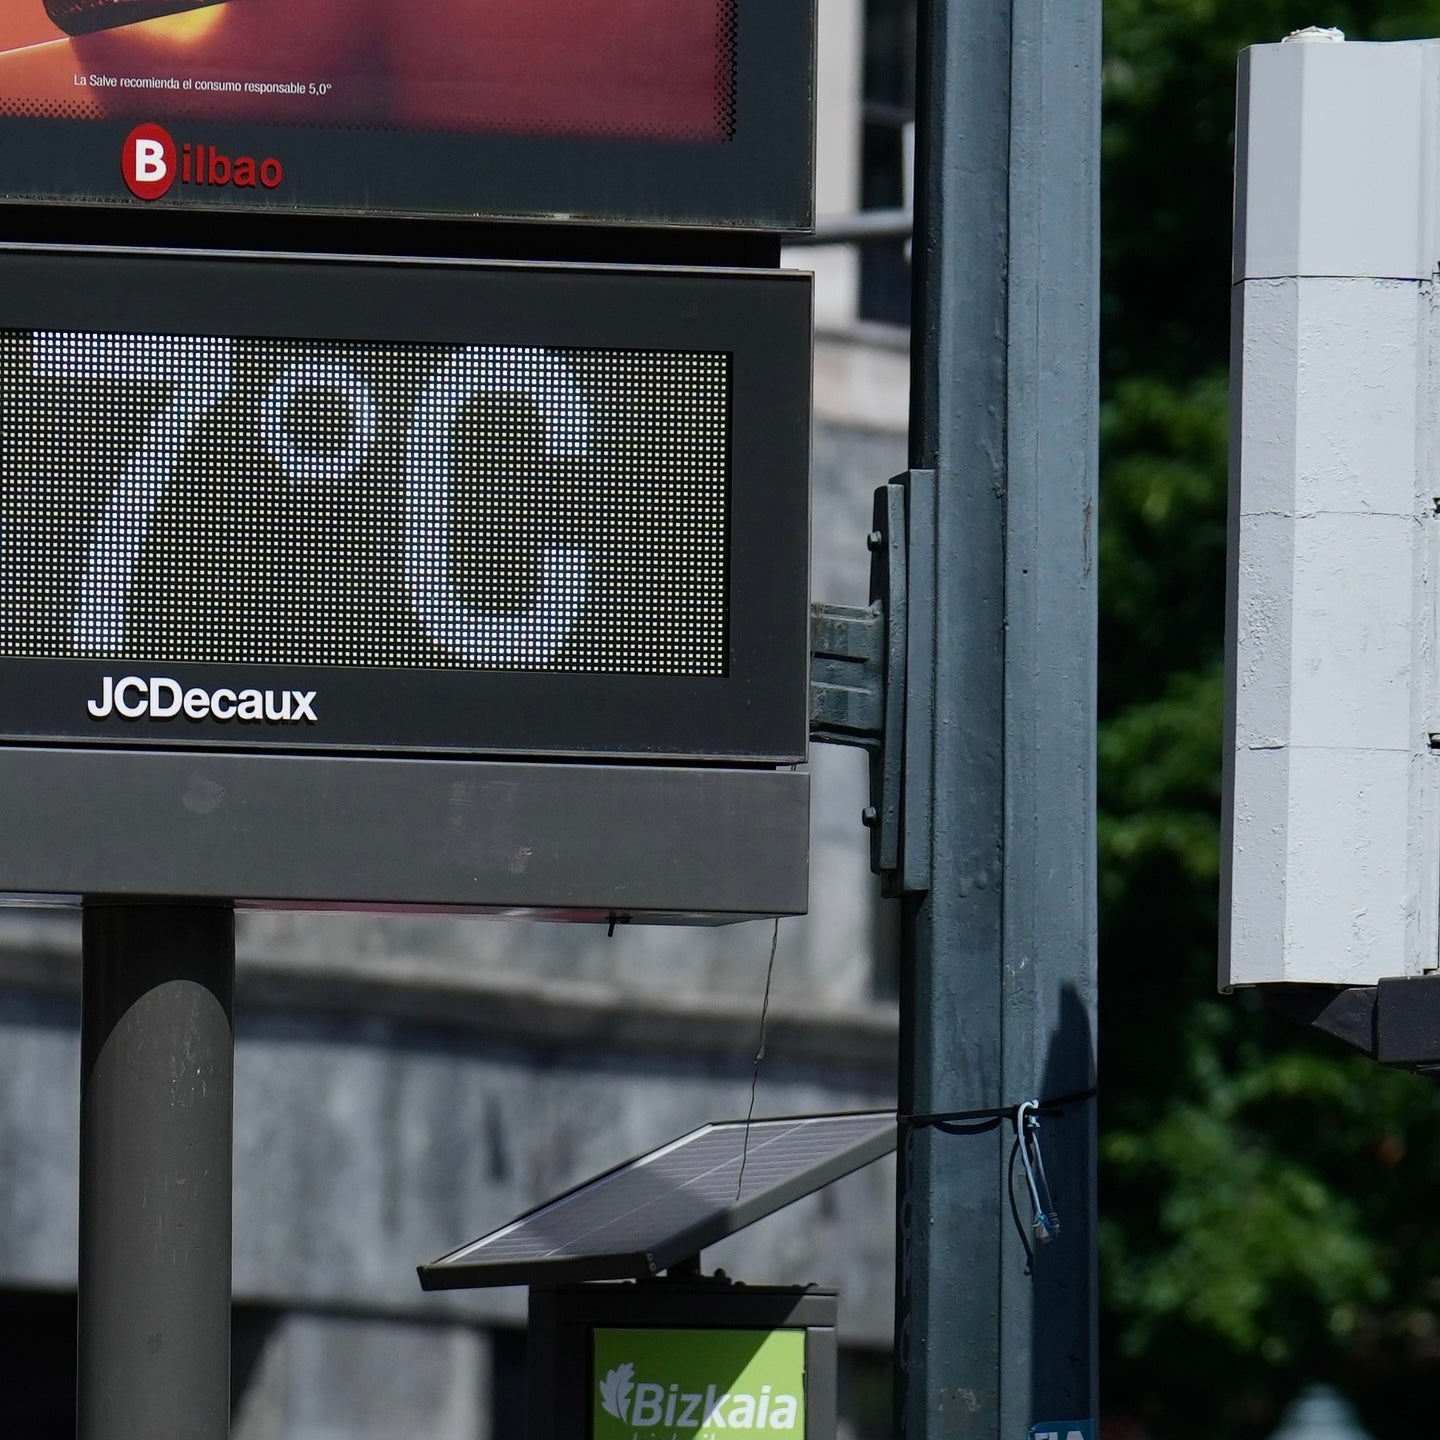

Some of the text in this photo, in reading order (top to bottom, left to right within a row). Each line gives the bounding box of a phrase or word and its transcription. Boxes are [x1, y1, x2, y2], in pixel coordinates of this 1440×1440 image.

[74, 74, 332, 96] La Salve recomienda el consumo responsable 5,0°
[135, 138, 283, 188] Bilbao
[87, 675, 319, 723] JCDecaux
[631, 1383, 798, 1430] Bizkaia
